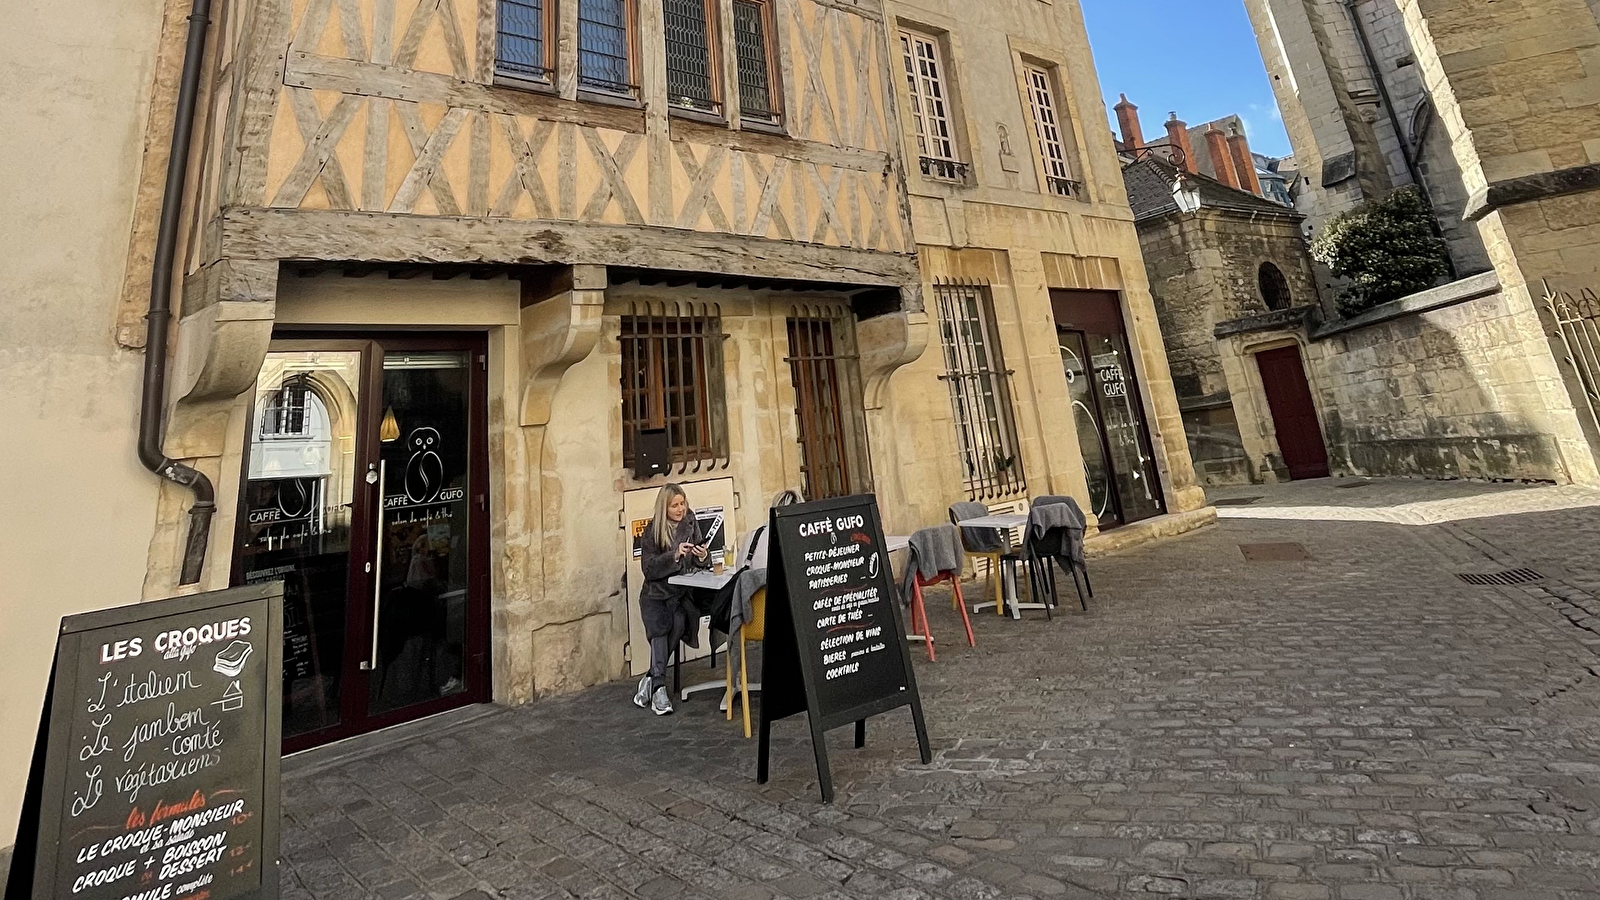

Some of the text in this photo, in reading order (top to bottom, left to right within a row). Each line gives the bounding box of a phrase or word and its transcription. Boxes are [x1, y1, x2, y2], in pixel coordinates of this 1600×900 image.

[1103, 382, 1126, 396] GUFO
[440, 490, 464, 500] GUFO
[799, 514, 864, 537] CAFFÈ GUFO
[804, 543, 860, 561] PETITS-DÉJEUNER
[806, 556, 865, 576] CROQUE-MONSIEUR
[813, 597, 833, 610] CAFÉS
[834, 595, 842, 606] DE
[816, 608, 863, 629] CARTE DE THÉS
[101, 617, 252, 663] LES CROQUES
[820, 633, 854, 651] SÉLECTION
[855, 630, 864, 641] DE
[865, 626, 882, 638] VINS
[825, 661, 860, 680] COCKTAILS
[88, 670, 202, 713] L'italien
[79, 702, 210, 762] Le jambon
[72, 749, 221, 817] Le végétariens
[125, 789, 207, 829] les formules
[76, 842, 100, 864] LE
[101, 798, 245, 857] CROQUE-MONSIEUR
[72, 831, 227, 894] CROQUE + BOISSON
[158, 845, 228, 881] DESSERT
